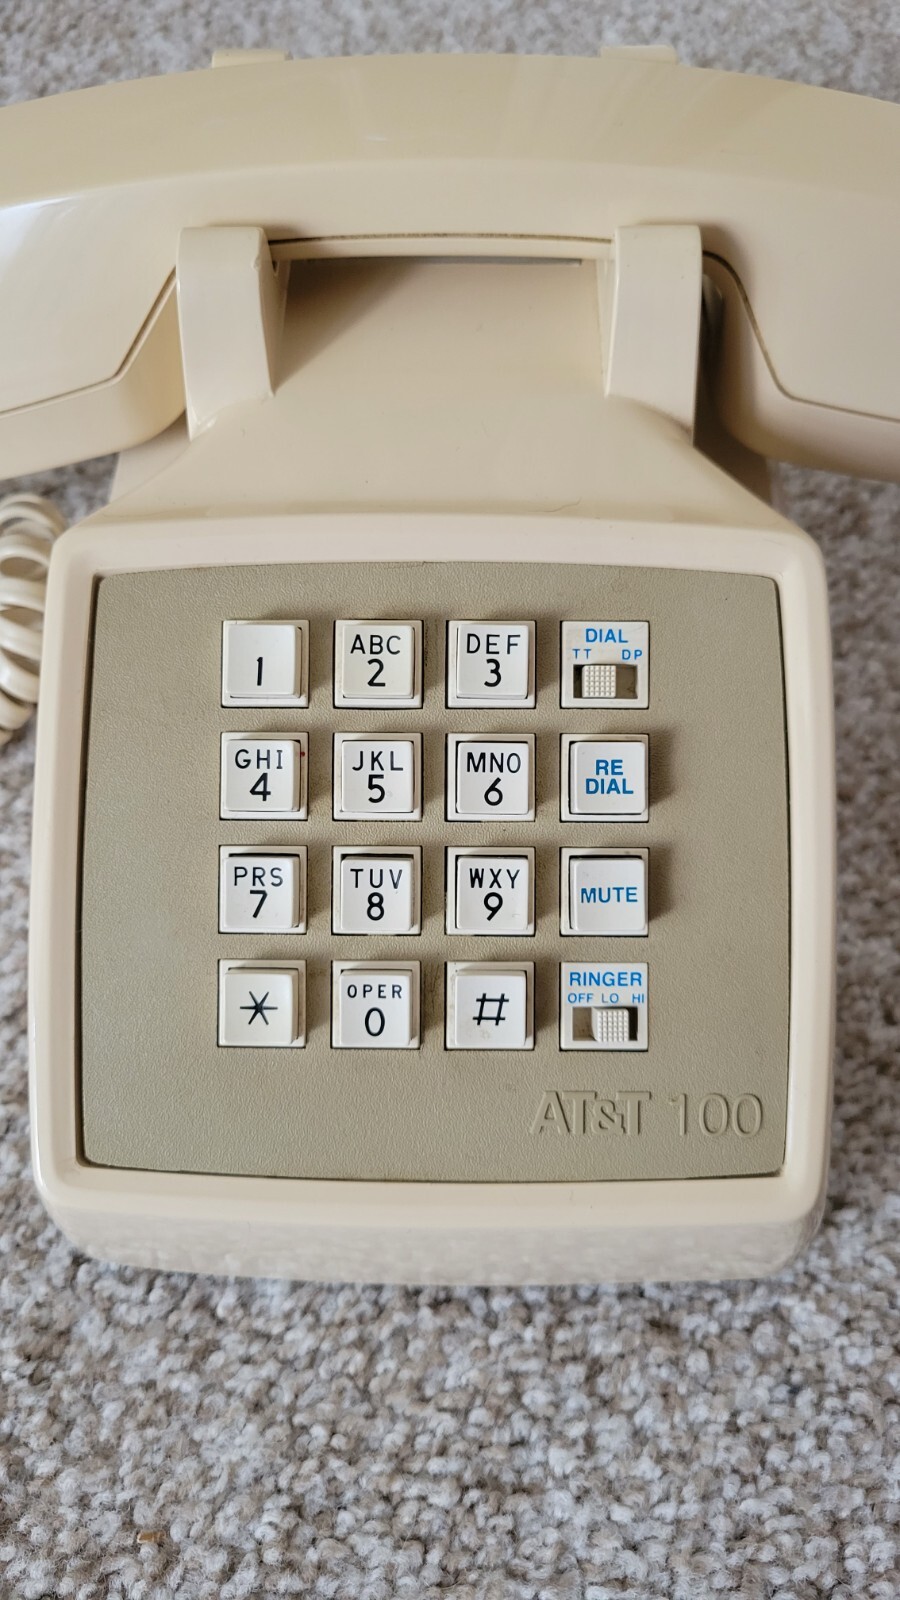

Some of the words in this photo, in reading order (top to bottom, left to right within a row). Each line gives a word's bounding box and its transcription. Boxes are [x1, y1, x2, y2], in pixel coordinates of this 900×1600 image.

[350, 634, 401, 655] ABC
[467, 633, 521, 654] DEF
[585, 628, 628, 643] DIAL
[256, 656, 264, 687] 1
[367, 658, 386, 687] 2
[484, 658, 501, 687] 3
[234, 749, 282, 769] GHI
[352, 750, 403, 771] JKL
[467, 752, 521, 773] MNO
[595, 760, 623, 775] RE
[249, 773, 271, 801] 4
[368, 775, 385, 803] 5
[484, 777, 502, 806] 6
[585, 778, 633, 794] DIAL
[234, 866, 282, 887] PRS
[350, 868, 402, 888] TUV
[469, 869, 519, 889] WXY
[249, 890, 267, 918] 7
[581, 887, 638, 903] MUTE
[367, 892, 384, 921] 8
[483, 893, 502, 921] 9
[569, 972, 642, 987] RINGER
[347, 984, 402, 998] OPER
[567, 993, 594, 1004] OFF
[602, 993, 619, 1004] LO
[632, 993, 645, 1004] HI
[473, 993, 509, 1025] #
[365, 1008, 385, 1036] 0
[530, 1090, 651, 1136] AT&T
[671, 1092, 763, 1137] 100
